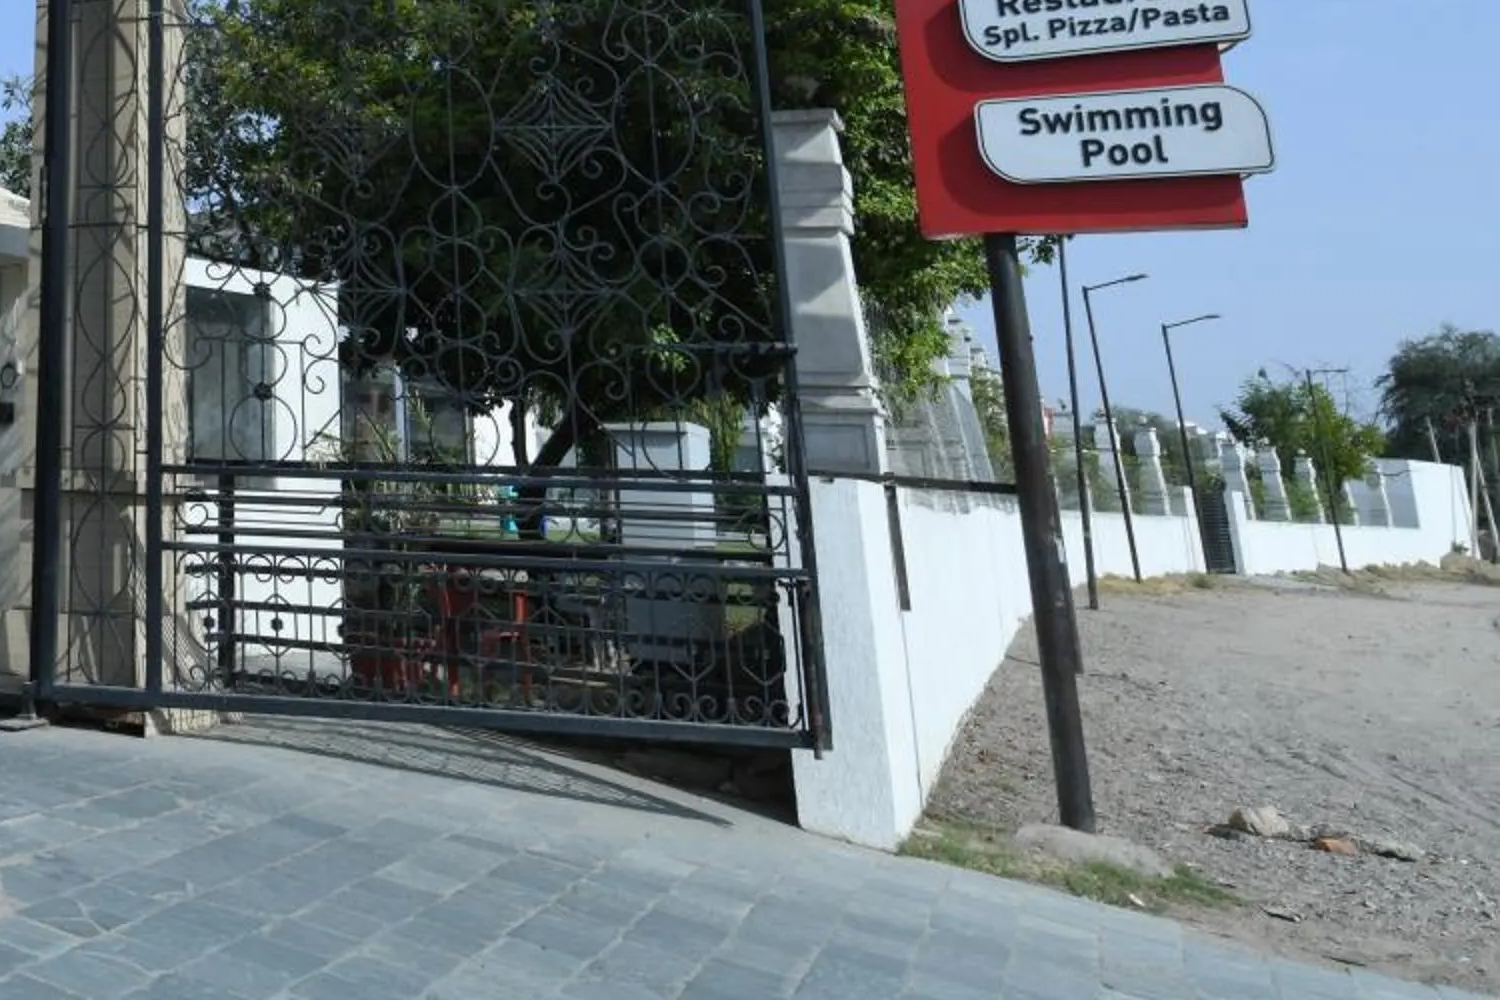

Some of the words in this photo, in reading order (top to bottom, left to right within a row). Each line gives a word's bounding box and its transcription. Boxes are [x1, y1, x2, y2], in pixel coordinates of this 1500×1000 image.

[983, 22, 1040, 50] Spl.
[1047, 3, 1231, 41] Pizza/Pasta
[1017, 97, 1224, 137] Swimming
[1080, 134, 1170, 168] Pool
